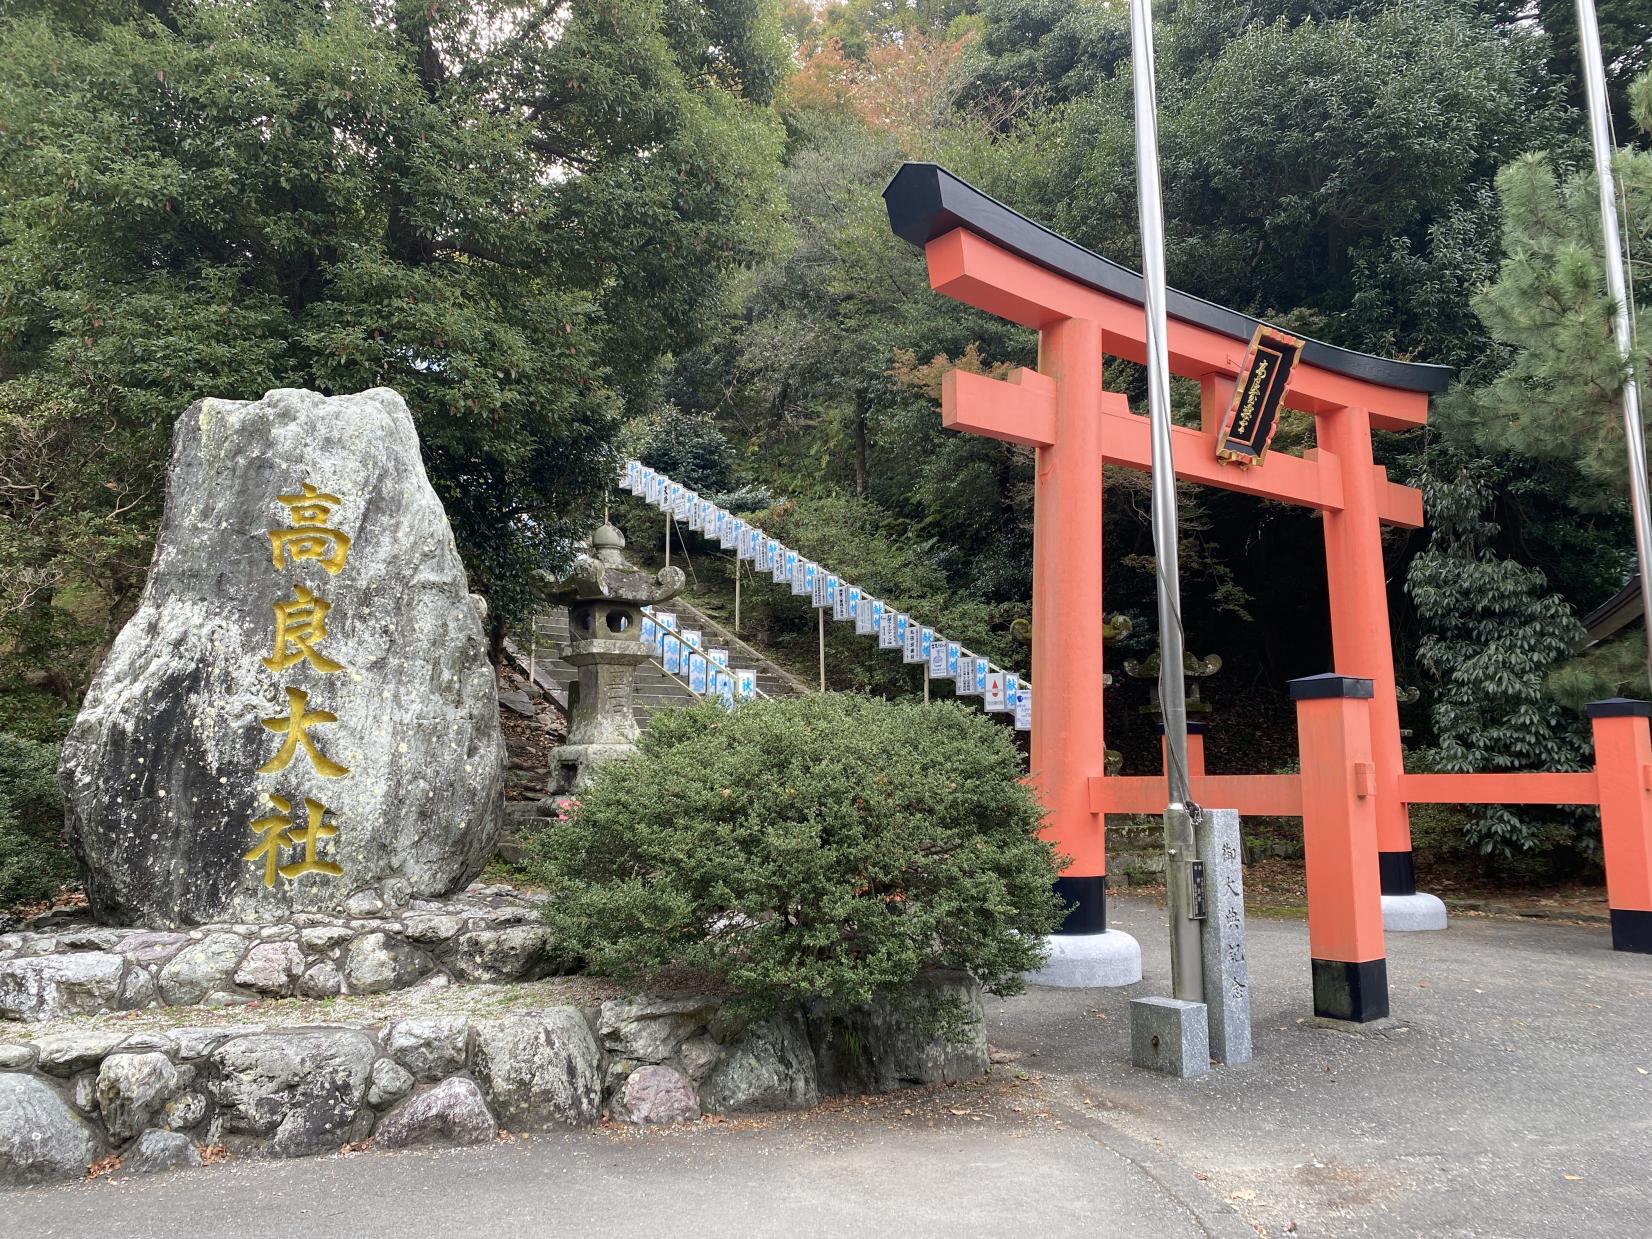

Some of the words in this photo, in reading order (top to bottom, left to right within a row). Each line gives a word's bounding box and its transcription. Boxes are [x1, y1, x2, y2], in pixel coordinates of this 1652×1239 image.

[243, 482, 352, 888] 高良大社
[1221, 842, 1246, 1000] 御大典記念
